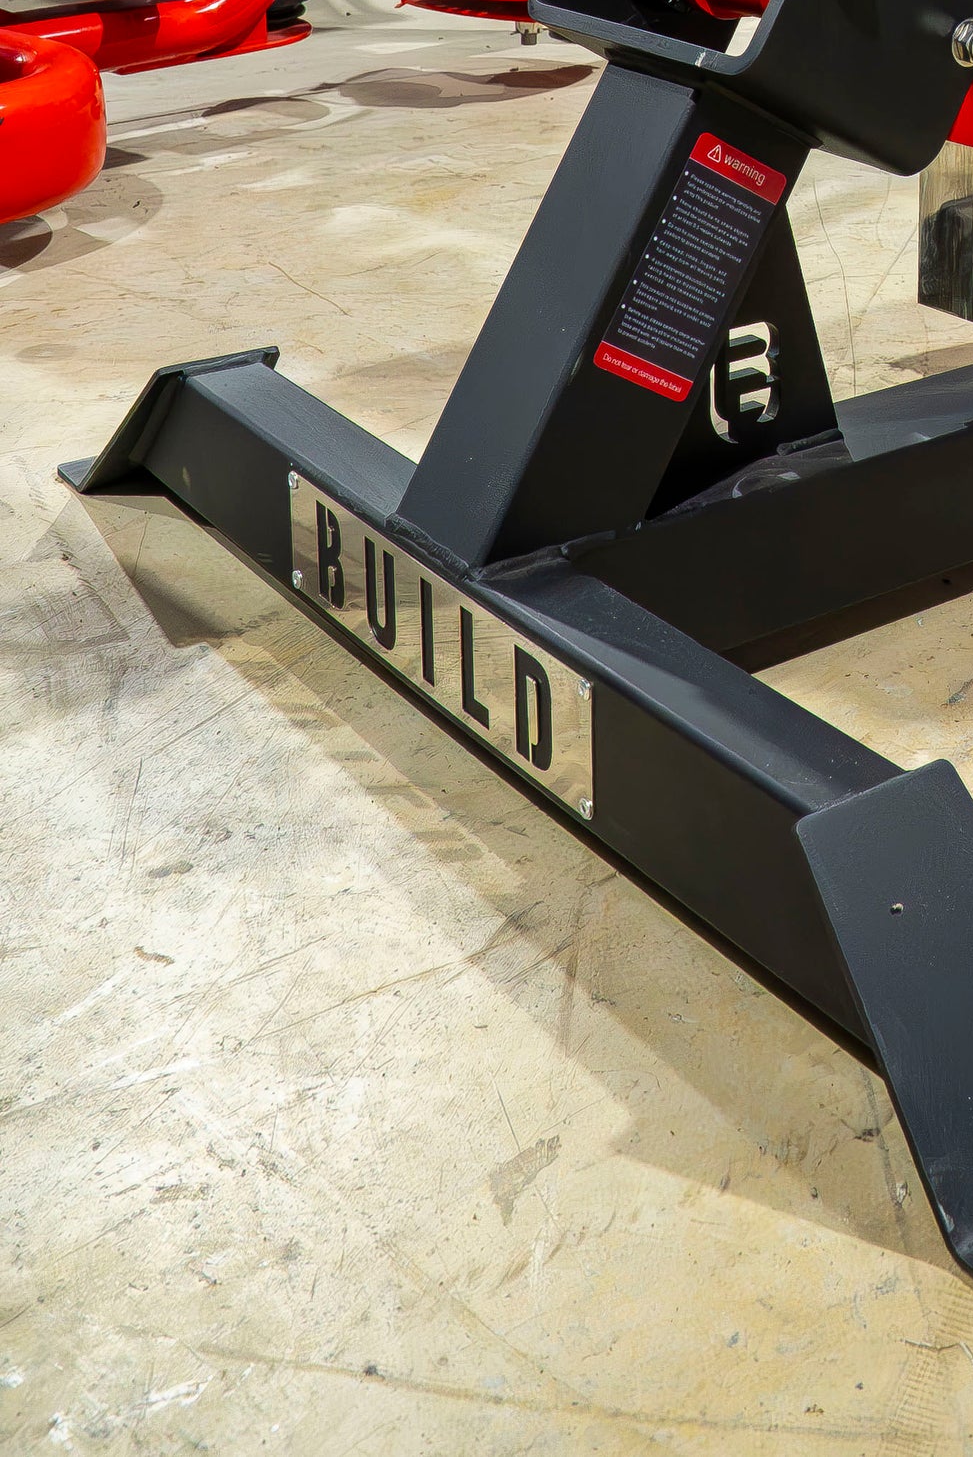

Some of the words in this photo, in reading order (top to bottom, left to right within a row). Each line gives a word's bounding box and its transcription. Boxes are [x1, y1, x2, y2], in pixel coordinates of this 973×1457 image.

[724, 154, 766, 186] warning
[602, 352, 613, 362] Do
[610, 356, 622, 367] not
[316, 500, 554, 772] BUILD
